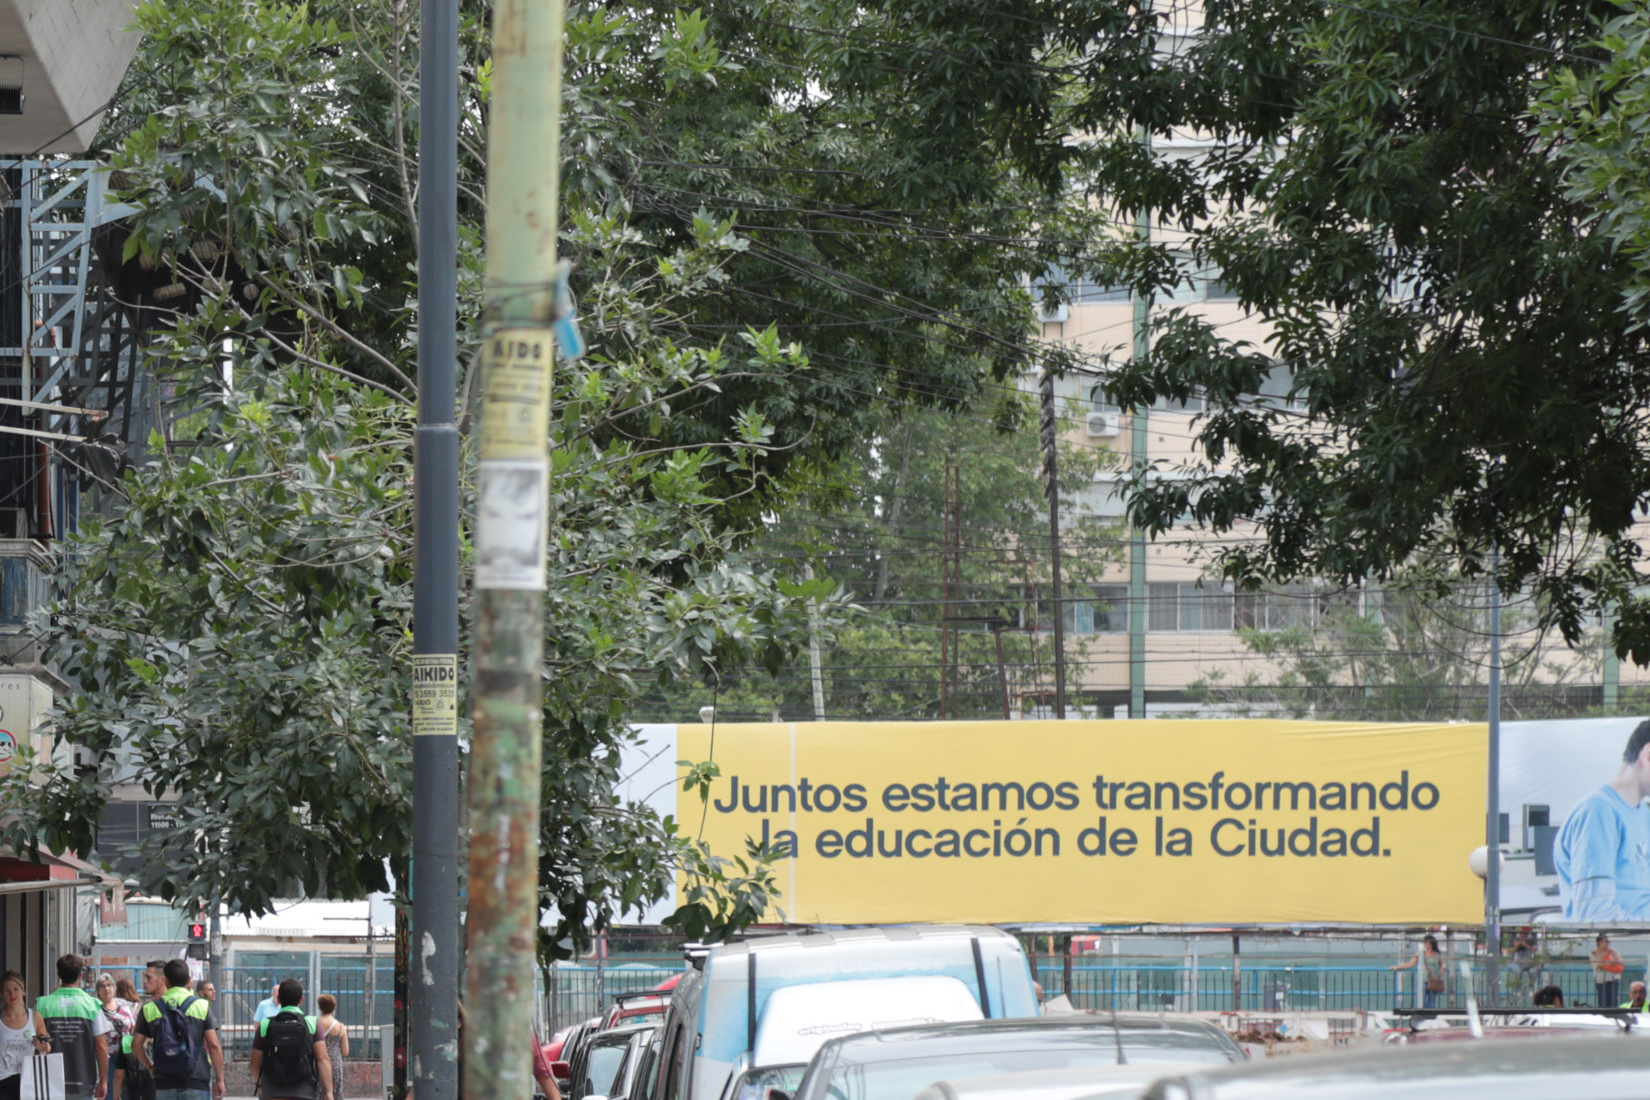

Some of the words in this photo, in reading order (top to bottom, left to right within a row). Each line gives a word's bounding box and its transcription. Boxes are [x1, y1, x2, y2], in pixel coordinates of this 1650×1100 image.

[414, 666, 455, 682] AIKIDO
[714, 775, 867, 814] Juntos
[882, 776, 1080, 813] estamos
[1092, 769, 1440, 812] transformando
[762, 816, 798, 859] la
[816, 816, 1060, 859] educación
[1077, 816, 1137, 858] de
[1155, 816, 1193, 857] la
[1210, 815, 1392, 858] Ciudad.
